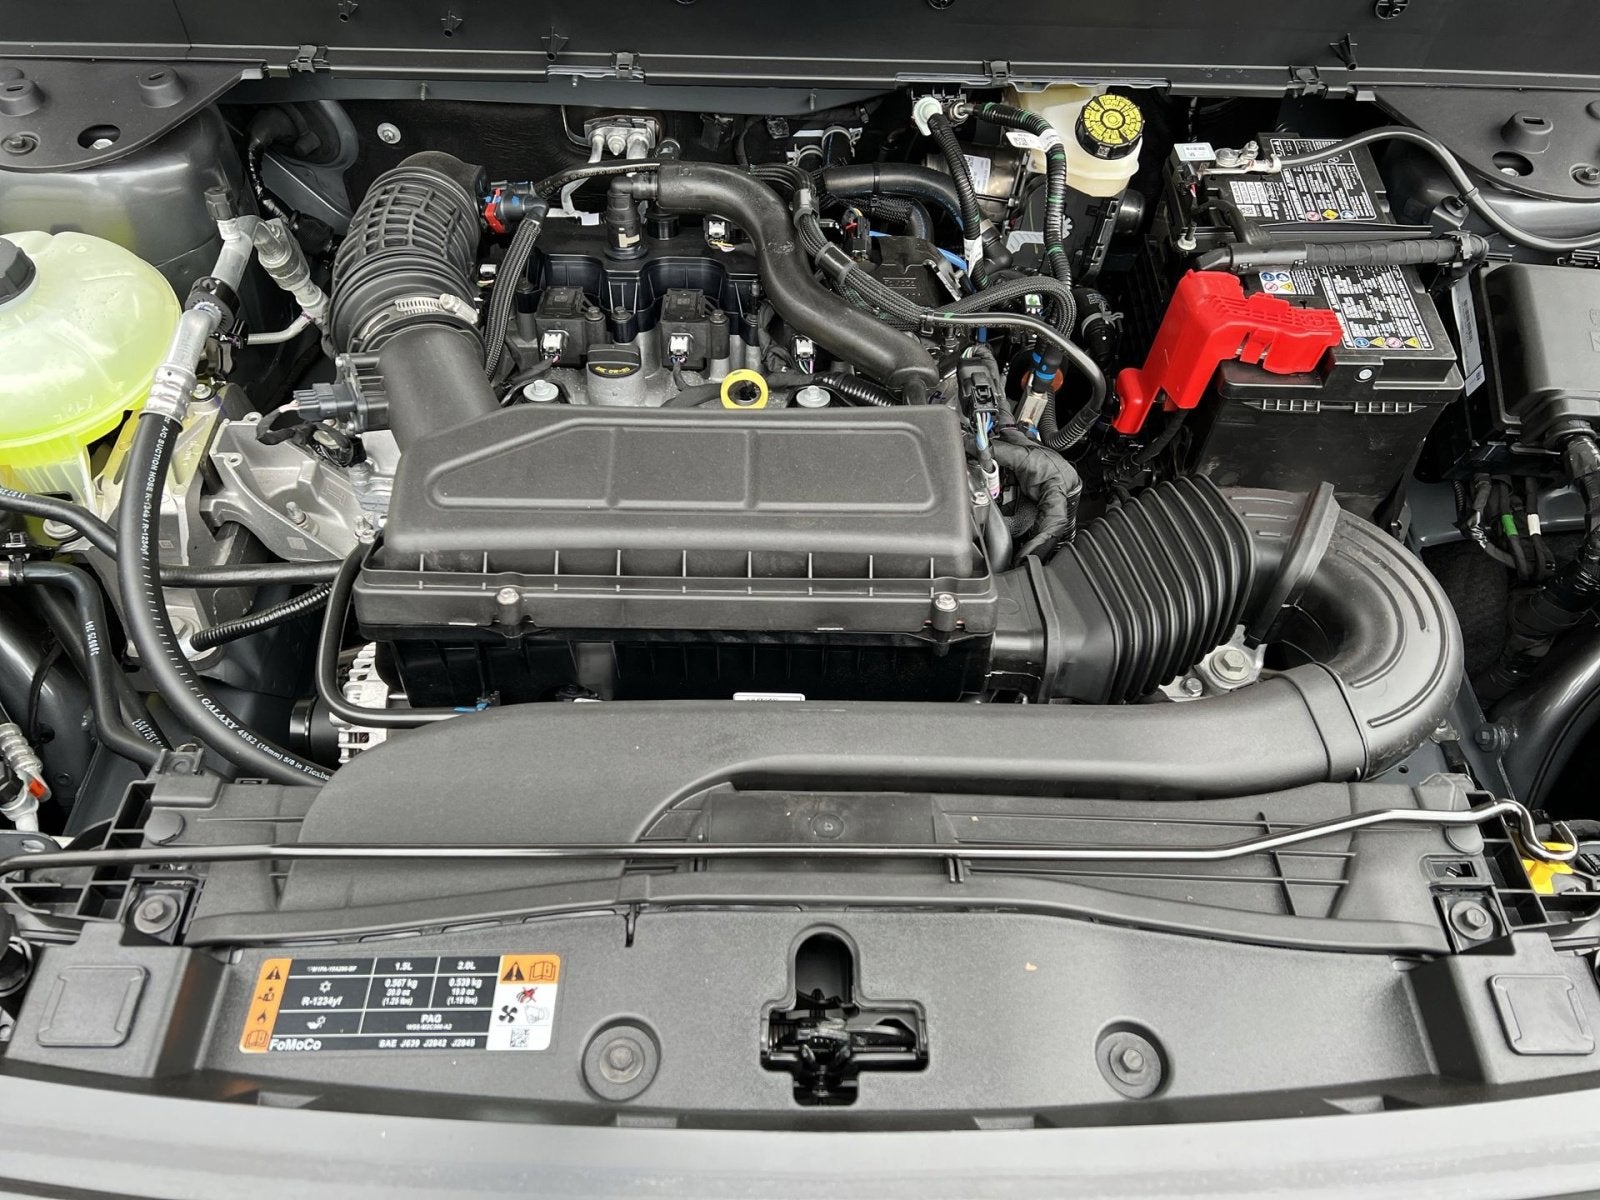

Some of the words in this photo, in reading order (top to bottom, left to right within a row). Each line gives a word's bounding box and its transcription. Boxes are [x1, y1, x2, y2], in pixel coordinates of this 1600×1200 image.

[160, 425, 169, 439] A/C
[150, 438, 165, 471] SUCTION
[145, 471, 157, 492] HOSE
[140, 523, 149, 555] R-1234yf
[201, 698, 239, 730] GALAXY
[256, 742, 283, 761] (16mm)
[294, 760, 303, 769] in
[395, 962, 413, 971] 1.5L
[457, 961, 476, 970] 2.0L
[406, 979, 418, 989] kg
[471, 978, 482, 989] kg
[301, 996, 343, 1007] R-1234yf
[421, 1014, 442, 1023] PAG
[269, 1038, 322, 1051] FoMoCo
[378, 1039, 398, 1048] SAE
[400, 1039, 421, 1048] J639
